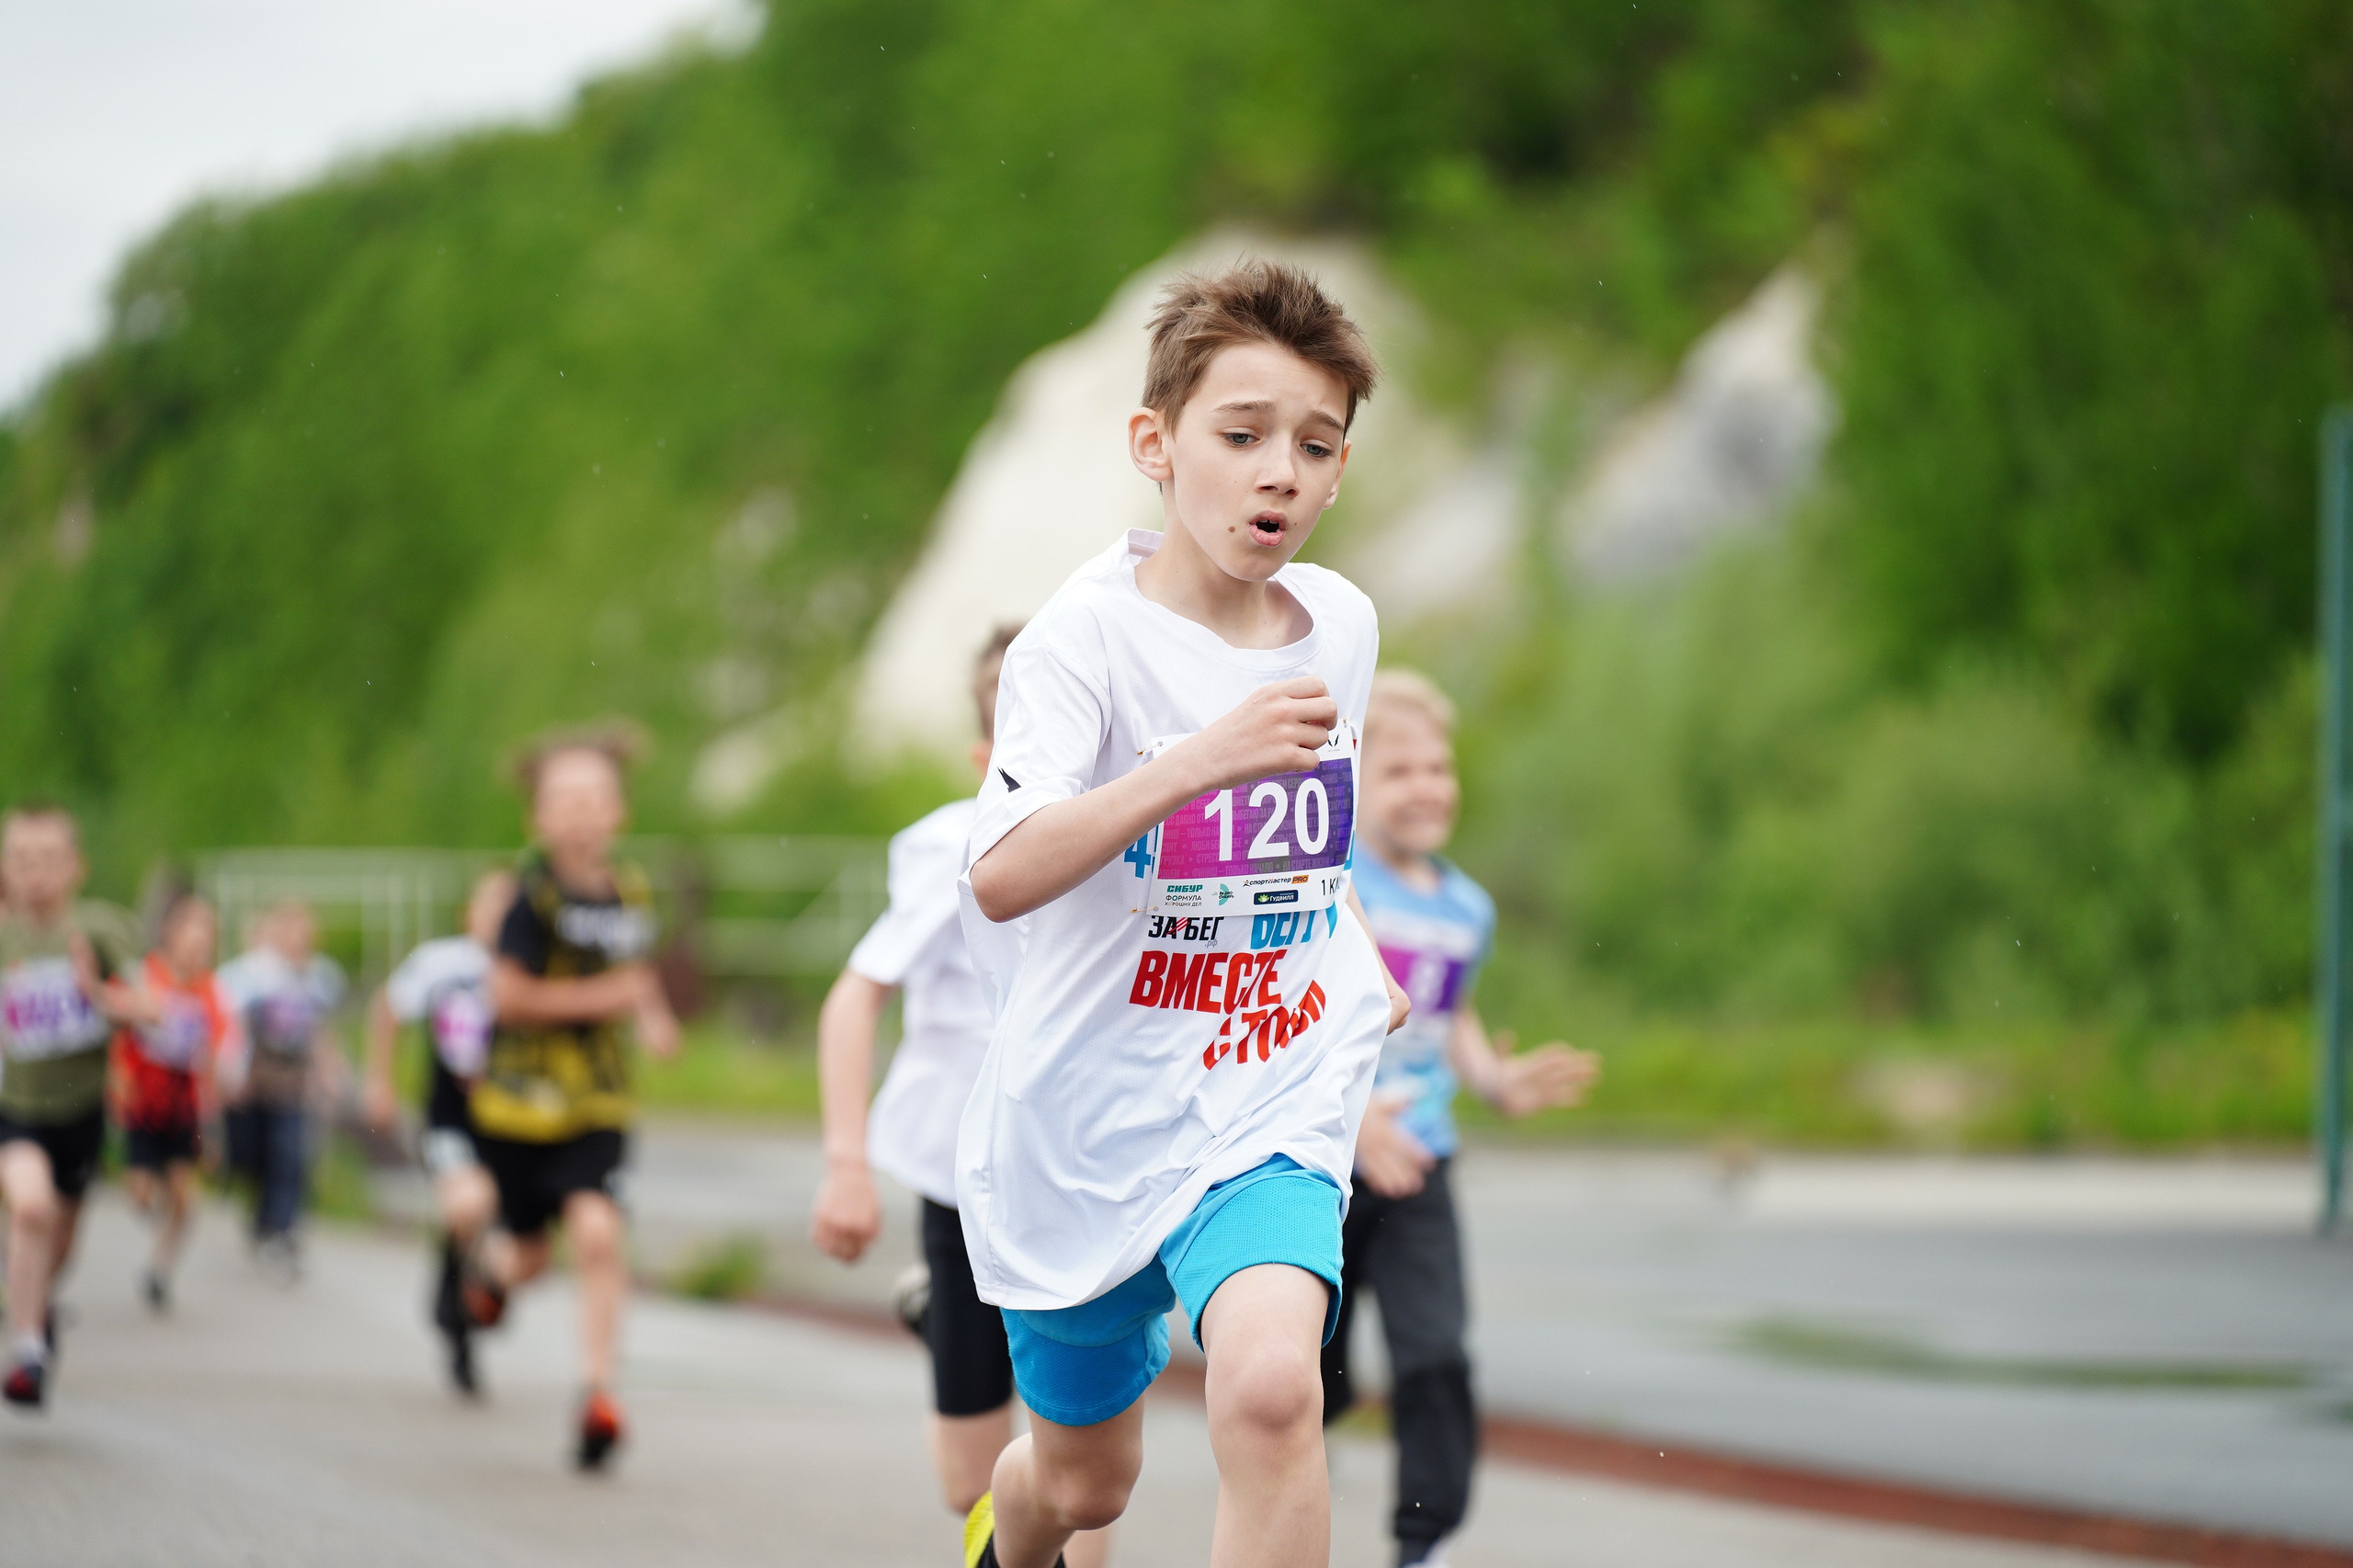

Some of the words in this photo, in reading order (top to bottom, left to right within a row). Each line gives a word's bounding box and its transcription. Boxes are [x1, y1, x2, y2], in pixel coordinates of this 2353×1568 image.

[1204, 778, 1329, 861] 120
[1166, 884, 1203, 893] СИБУР
[1129, 949, 1288, 1016] ВМЕСТЕ
